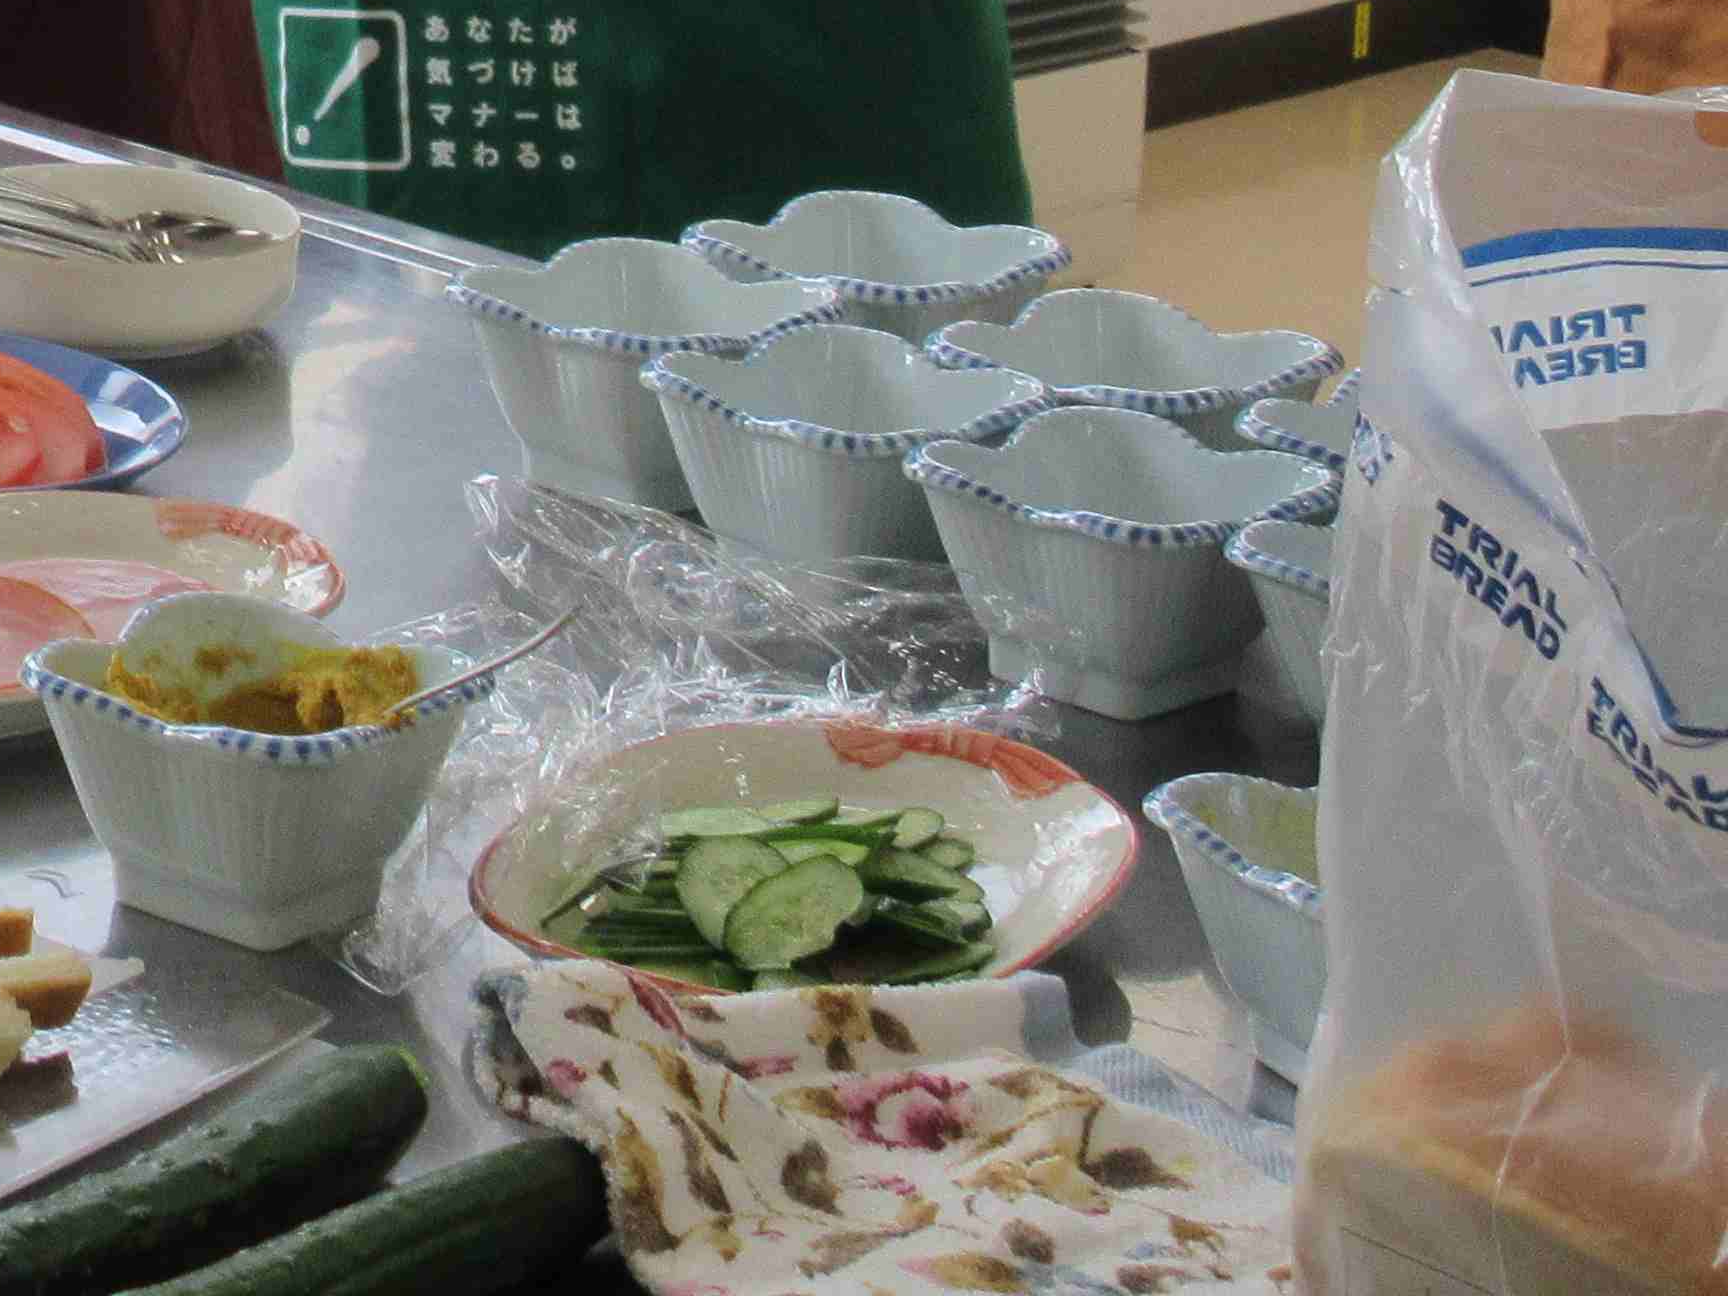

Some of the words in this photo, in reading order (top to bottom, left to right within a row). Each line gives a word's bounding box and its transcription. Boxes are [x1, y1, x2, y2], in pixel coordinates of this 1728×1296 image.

[424, 14, 578, 46] あなたが
[425, 56, 580, 88] 気づけば
[427, 101, 583, 131] マナーは
[1435, 497, 1569, 633] TRIAL
[1430, 535, 1561, 661] BREAD
